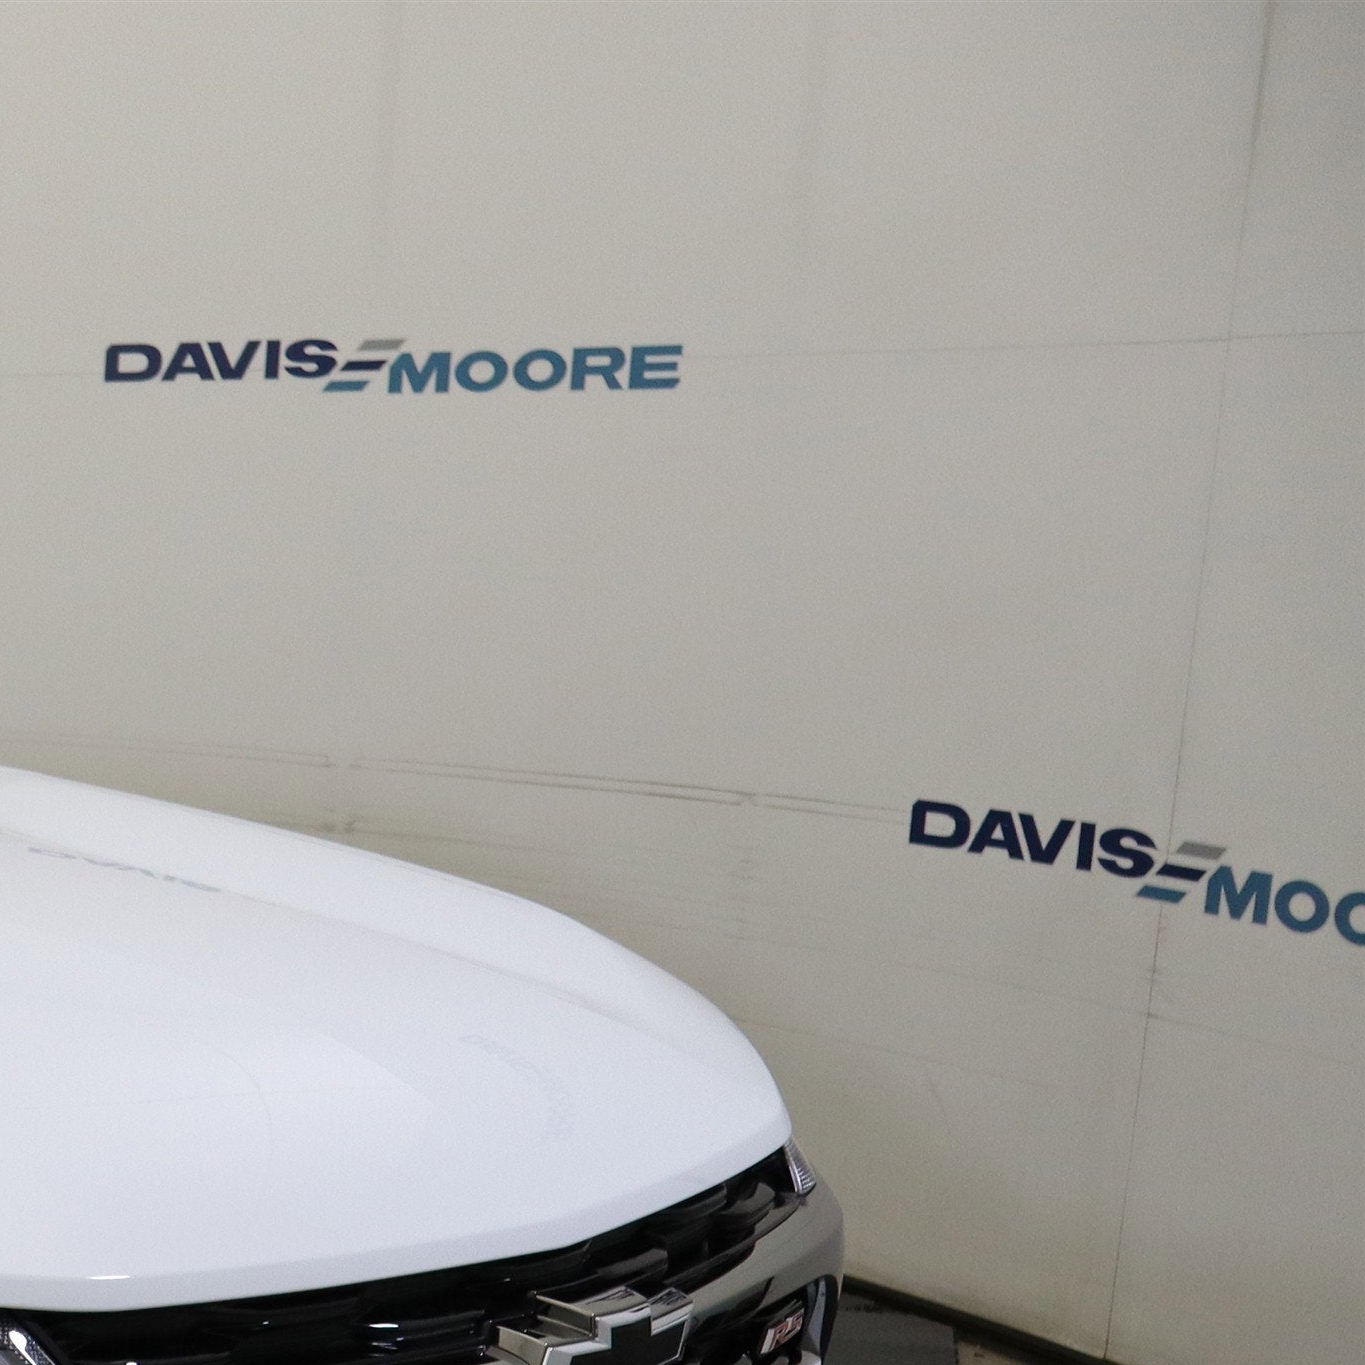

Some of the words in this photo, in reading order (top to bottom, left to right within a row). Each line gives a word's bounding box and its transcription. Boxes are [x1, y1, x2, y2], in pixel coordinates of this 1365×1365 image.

[103, 338, 338, 383] DAVIS
[386, 345, 683, 394] MOORE
[908, 798, 1157, 879] DAVIS
